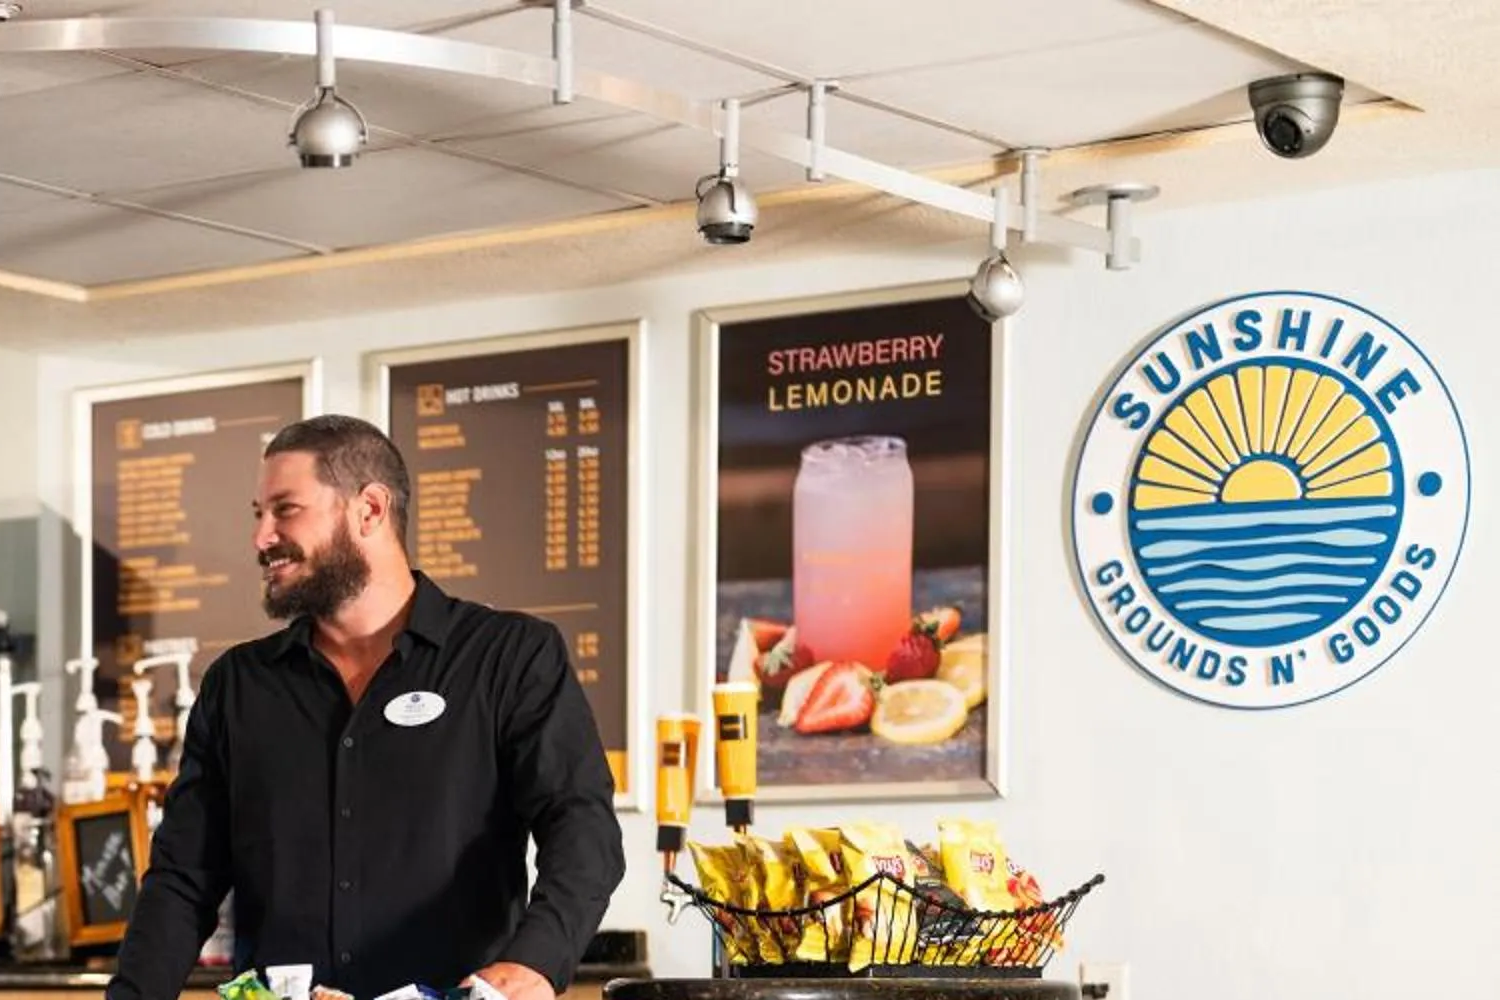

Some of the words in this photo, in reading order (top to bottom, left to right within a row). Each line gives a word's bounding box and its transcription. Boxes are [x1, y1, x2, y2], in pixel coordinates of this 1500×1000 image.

[768, 334, 944, 376] STRAWBERRY
[768, 370, 943, 412] LEMONADE
[1114, 309, 1422, 430] SUNSHINE
[1096, 559, 1247, 686] GROUNDS
[1329, 543, 1437, 664] GOODS
